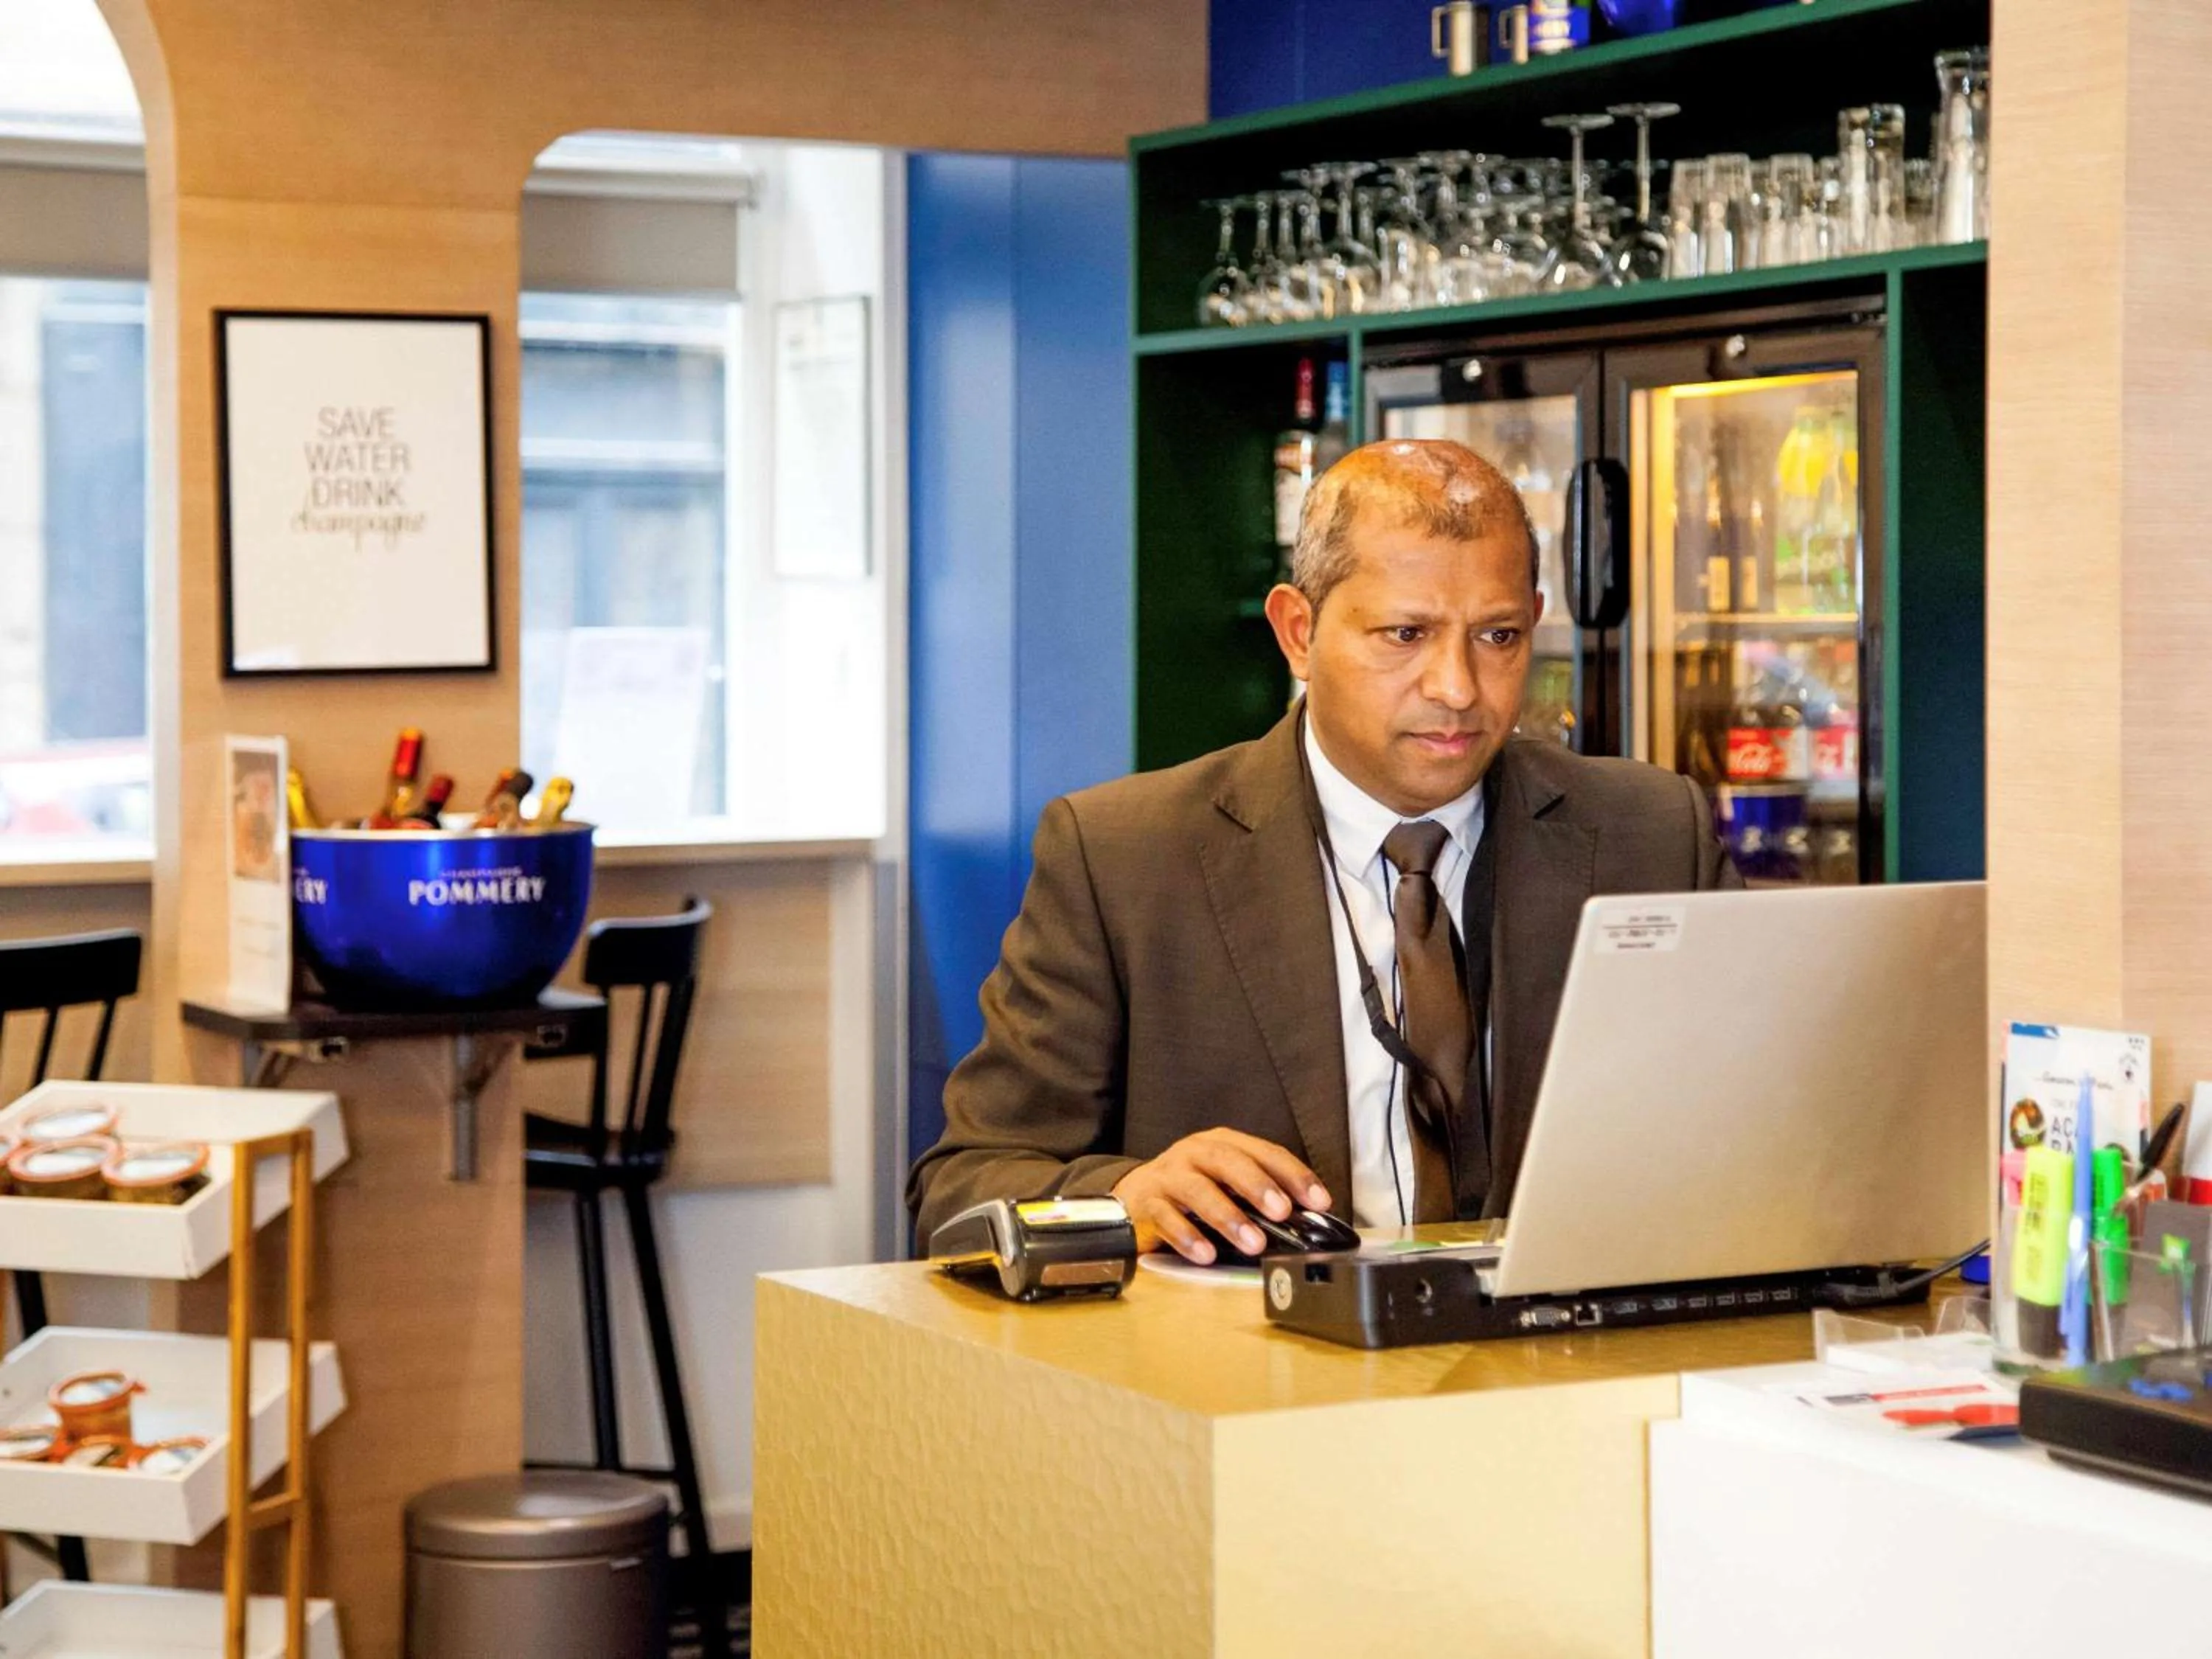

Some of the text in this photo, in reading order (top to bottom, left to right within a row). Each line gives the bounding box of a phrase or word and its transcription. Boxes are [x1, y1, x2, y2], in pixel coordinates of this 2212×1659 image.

[317, 406, 395, 437] SAVE
[303, 441, 412, 473] WATER
[311, 477, 406, 508] DRINK
[408, 877, 546, 906] POMMERY
